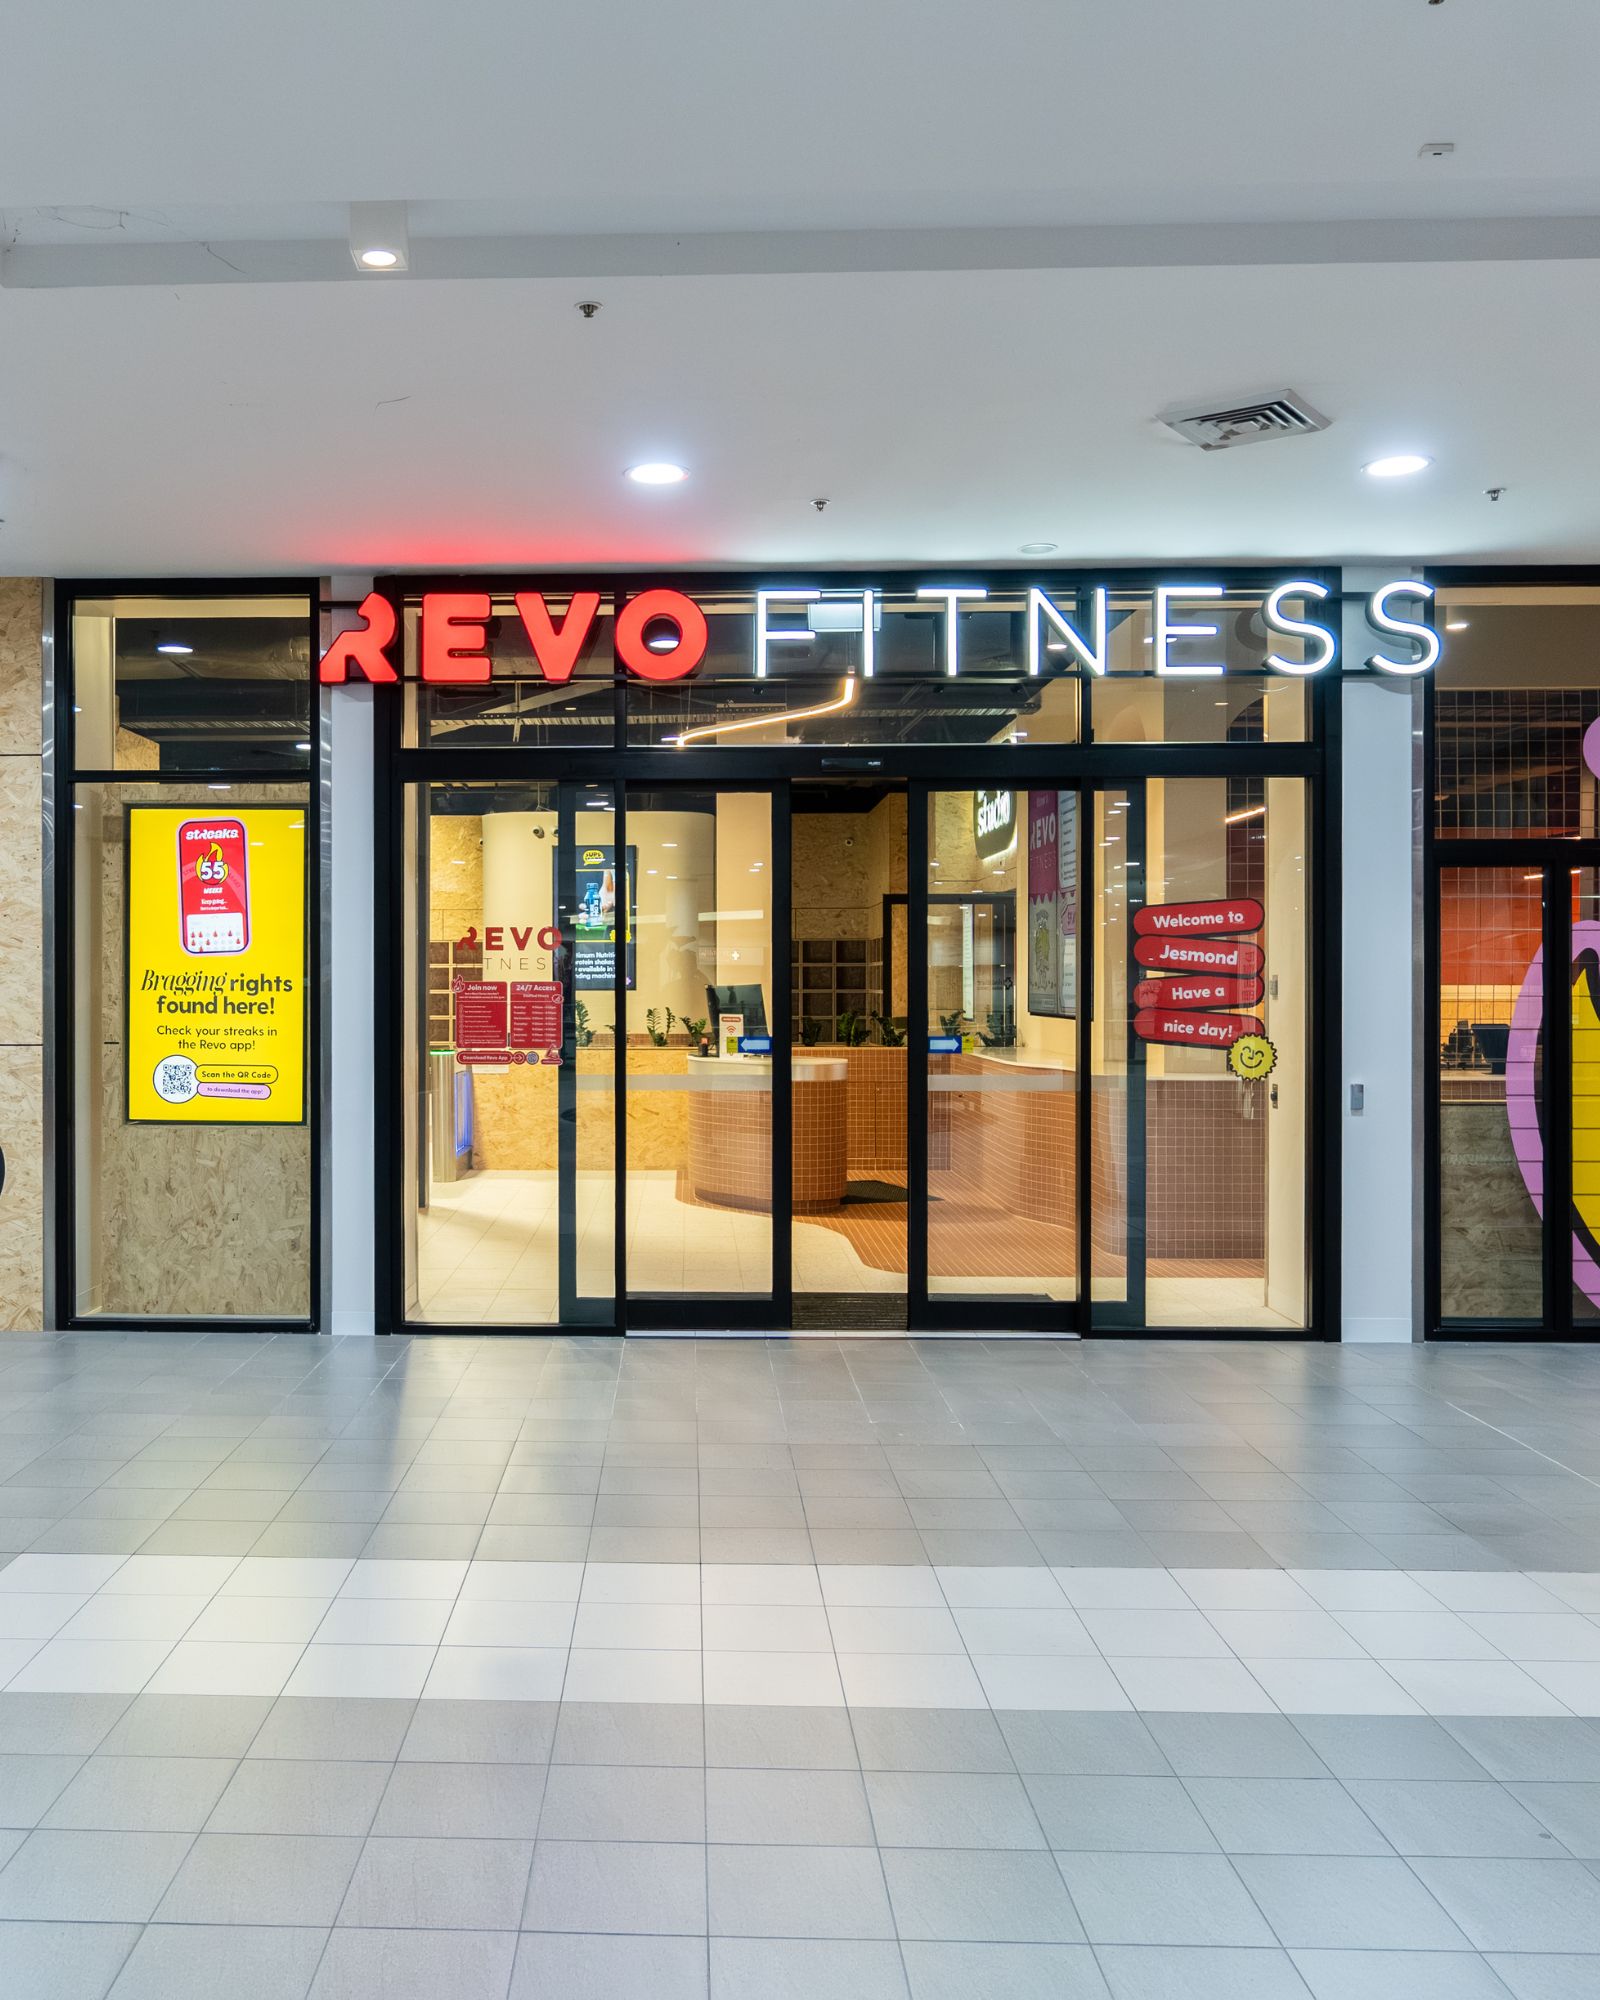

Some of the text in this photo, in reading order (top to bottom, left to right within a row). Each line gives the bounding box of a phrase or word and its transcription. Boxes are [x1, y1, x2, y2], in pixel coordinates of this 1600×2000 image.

[319, 581, 1441, 683] REVO FITNESS
[200, 861, 225, 880] 55
[1153, 911, 1244, 929] Welcome to
[456, 926, 562, 951] REVO
[1160, 945, 1238, 965] Jesmond
[141, 969, 293, 996] Bragging rights
[467, 984, 481, 992] Join
[516, 984, 556, 992] 24/7 Access
[1172, 987, 1225, 1000] Have a
[157, 995, 275, 1015] found here!
[157, 1025, 277, 1037] Check your streaks in
[1164, 1020, 1233, 1040] nice day!
[178, 1039, 255, 1051] the Revo app!
[237, 1071, 249, 1079] QR
[251, 1071, 271, 1079] Code
